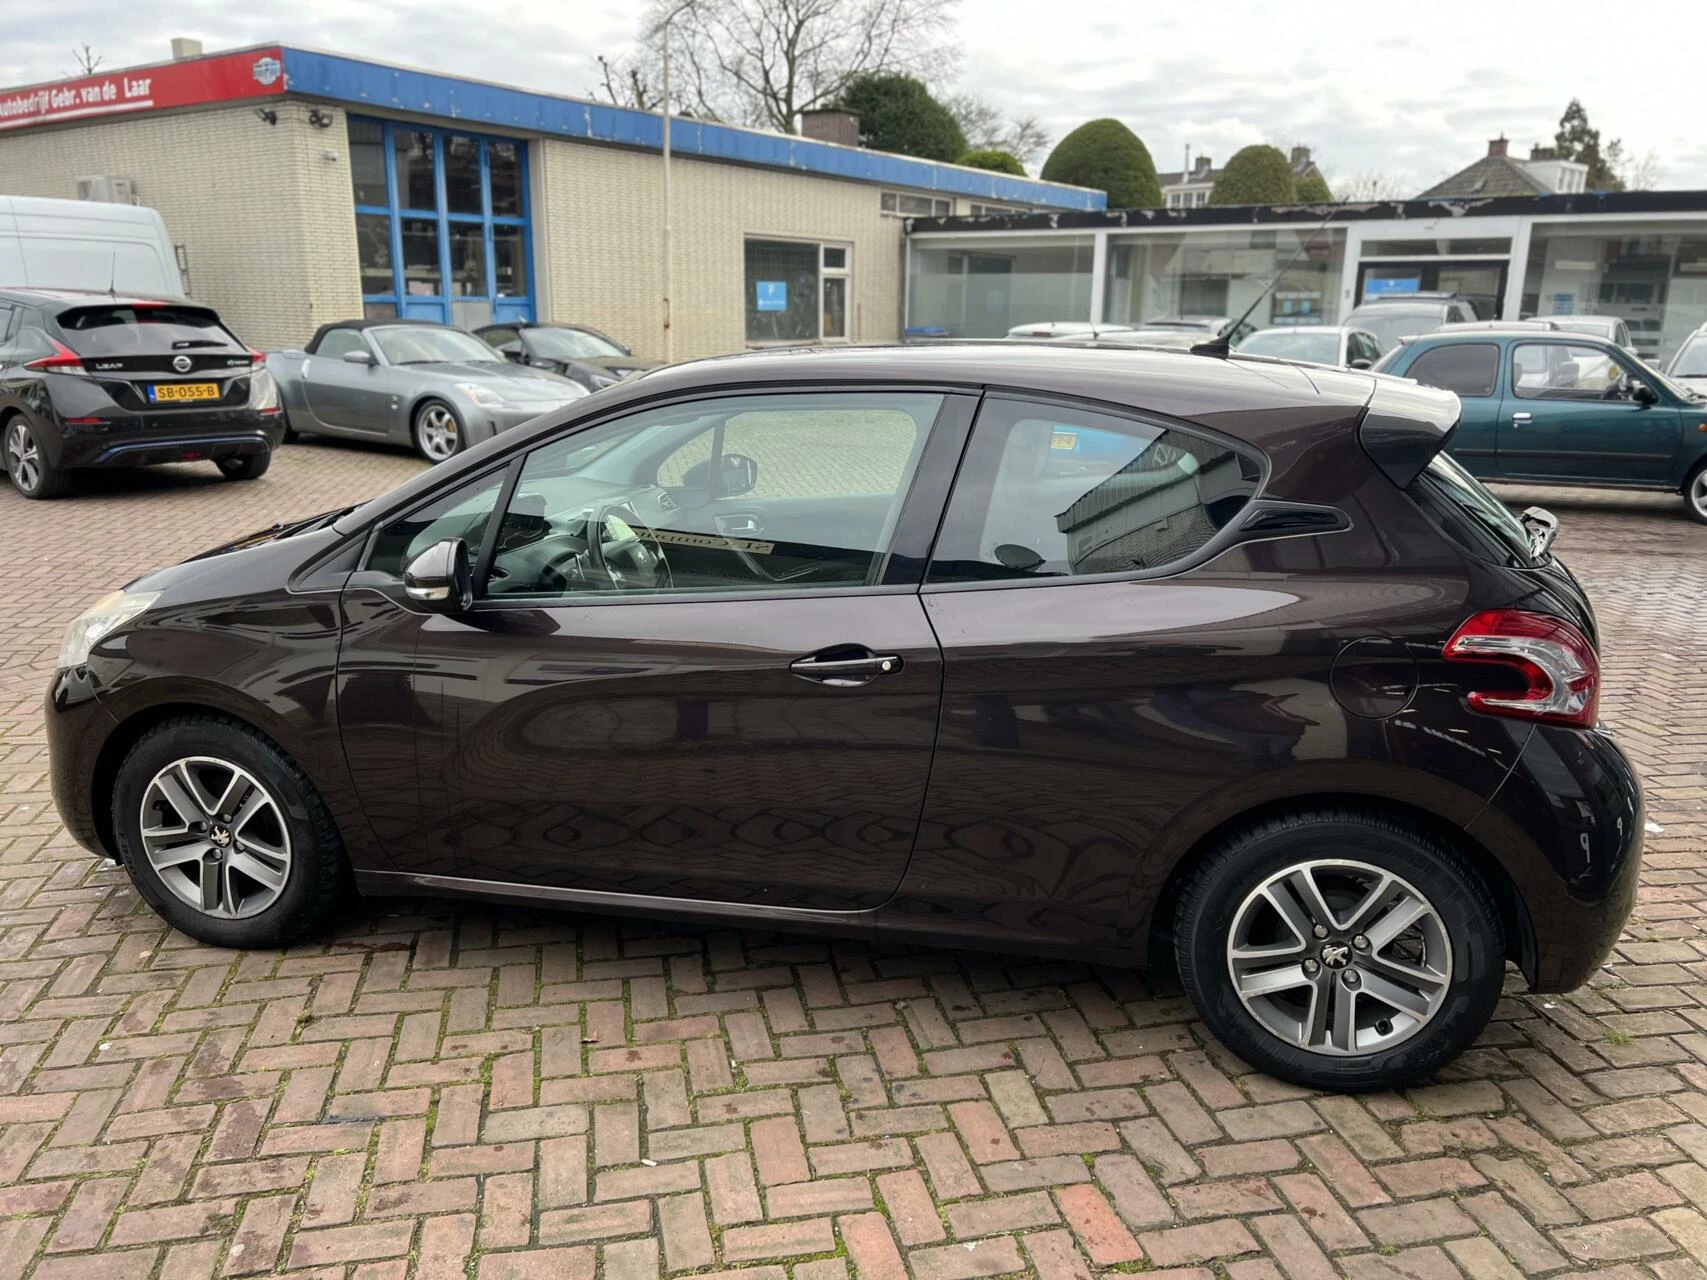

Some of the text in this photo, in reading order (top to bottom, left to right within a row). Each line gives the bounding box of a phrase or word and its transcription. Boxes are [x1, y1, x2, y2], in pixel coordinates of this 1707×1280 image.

[51, 87, 80, 109] Gebr.
[80, 85, 101, 103] van
[102, 80, 117, 101] de
[123, 77, 152, 98] Laar
[157, 385, 215, 399] SB-055-B
